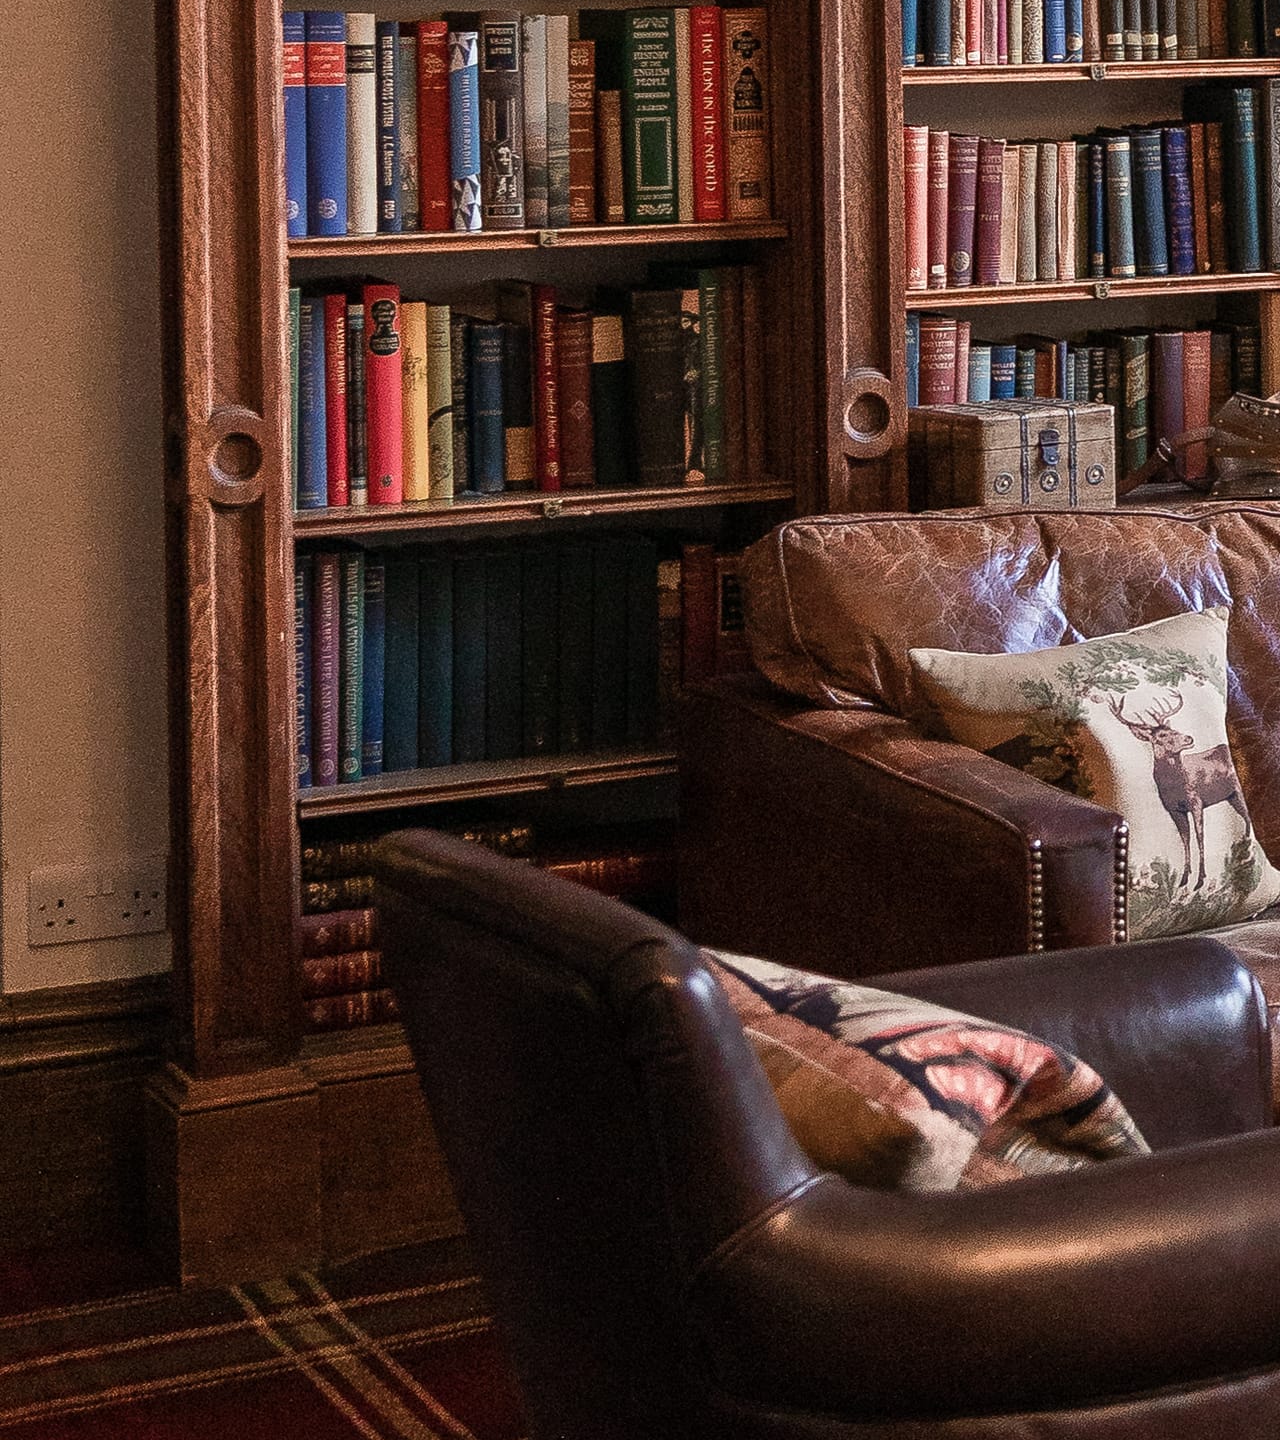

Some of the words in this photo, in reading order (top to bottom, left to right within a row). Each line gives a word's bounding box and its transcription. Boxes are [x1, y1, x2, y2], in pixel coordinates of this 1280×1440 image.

[381, 35, 394, 48] THE
[633, 51, 669, 60] HISTORY
[633, 68, 670, 77] ENGLISH
[636, 77, 668, 86] PEOPLE
[381, 102, 395, 127] SYSTEM
[384, 199, 397, 220] FOLIO
